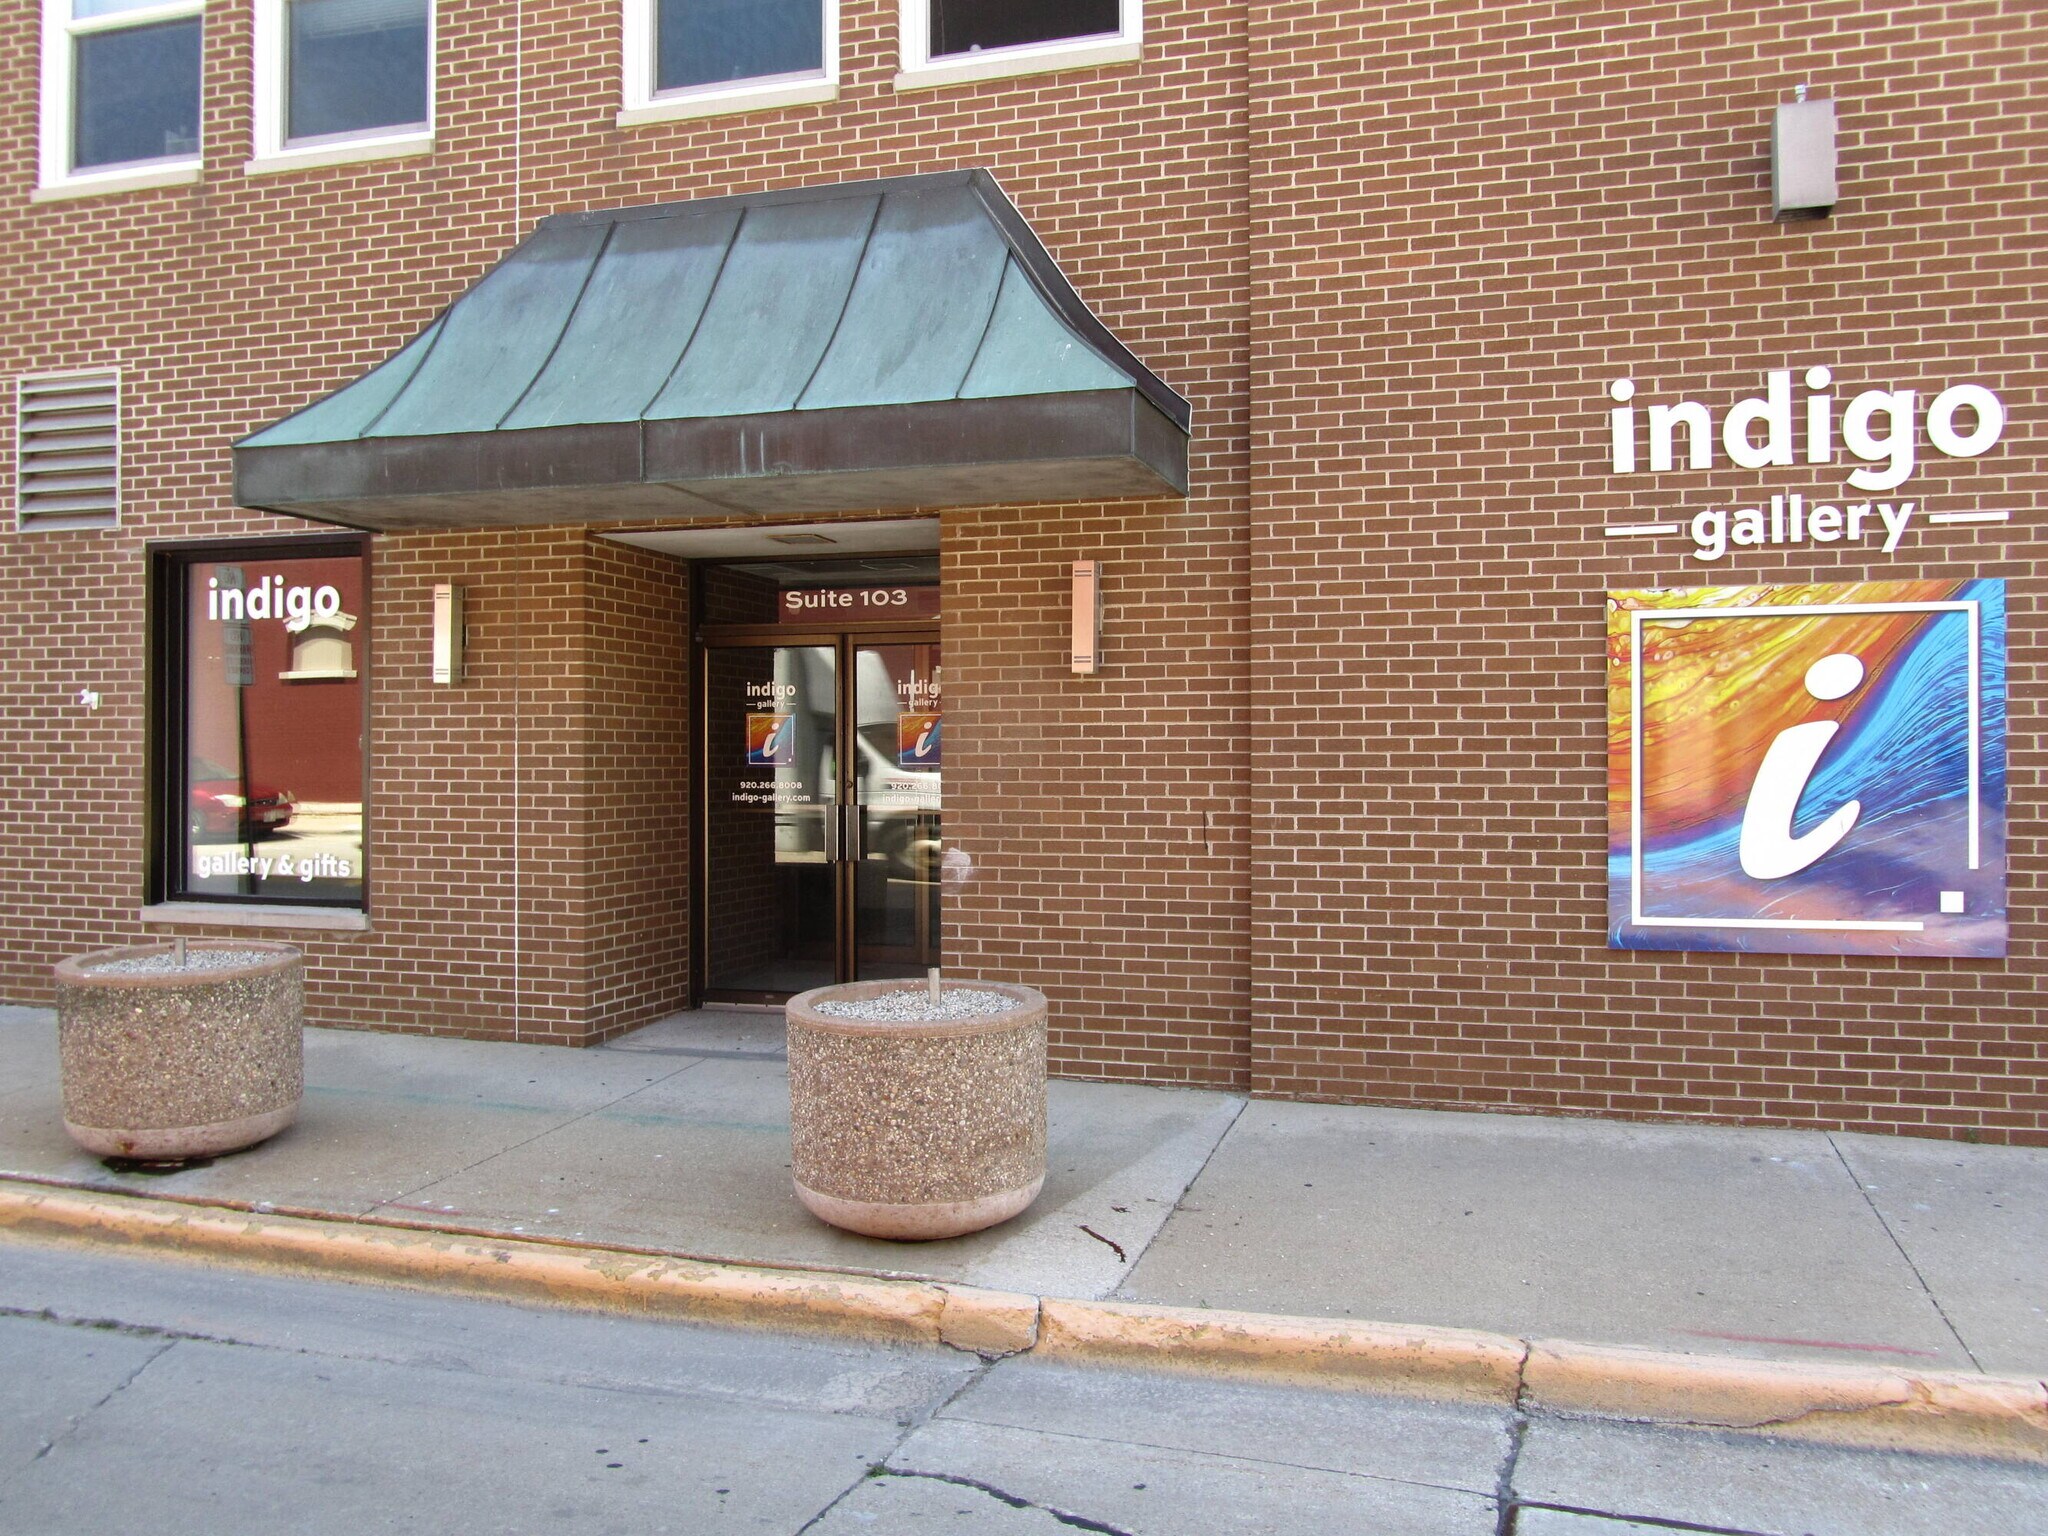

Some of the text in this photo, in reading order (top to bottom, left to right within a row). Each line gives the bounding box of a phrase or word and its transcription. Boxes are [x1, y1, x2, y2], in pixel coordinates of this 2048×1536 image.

[1610, 366, 2004, 491] indigo
[1690, 494, 1915, 561] gallery
[208, 574, 340, 632] indigo
[785, 589, 908, 609] Suite 103
[746, 681, 796, 700] indigo
[897, 679, 942, 698] indig
[757, 699, 785, 710] gallery
[908, 697, 938, 708] gallery
[740, 781, 803, 790] 920.266.8008
[732, 791, 811, 804] indigo-gallery.com
[198, 851, 351, 882] gallery & gifts
